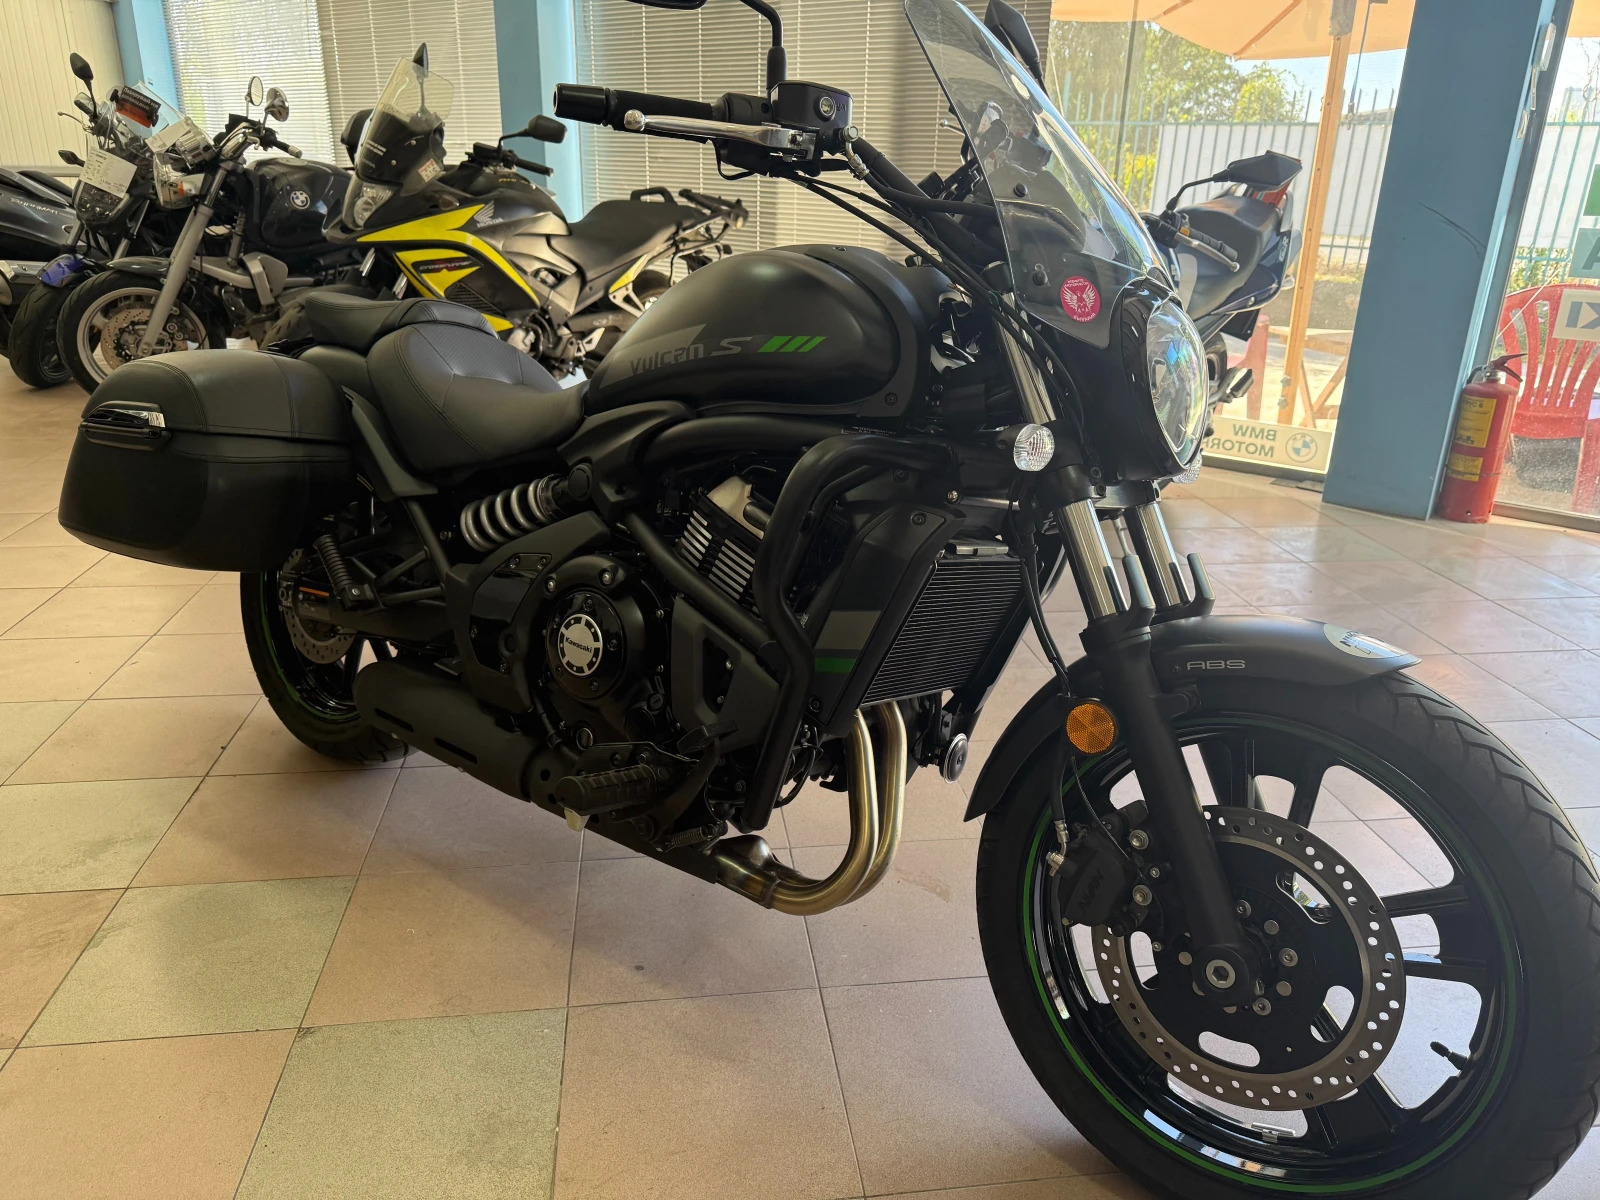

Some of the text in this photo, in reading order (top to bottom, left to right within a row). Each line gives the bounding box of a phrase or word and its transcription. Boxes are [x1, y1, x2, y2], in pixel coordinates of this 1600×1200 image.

[476, 217, 504, 228] HONDA
[630, 336, 753, 376] Vulcan S
[565, 636, 593, 653] Kawasaki
[1186, 659, 1246, 671] ABS
